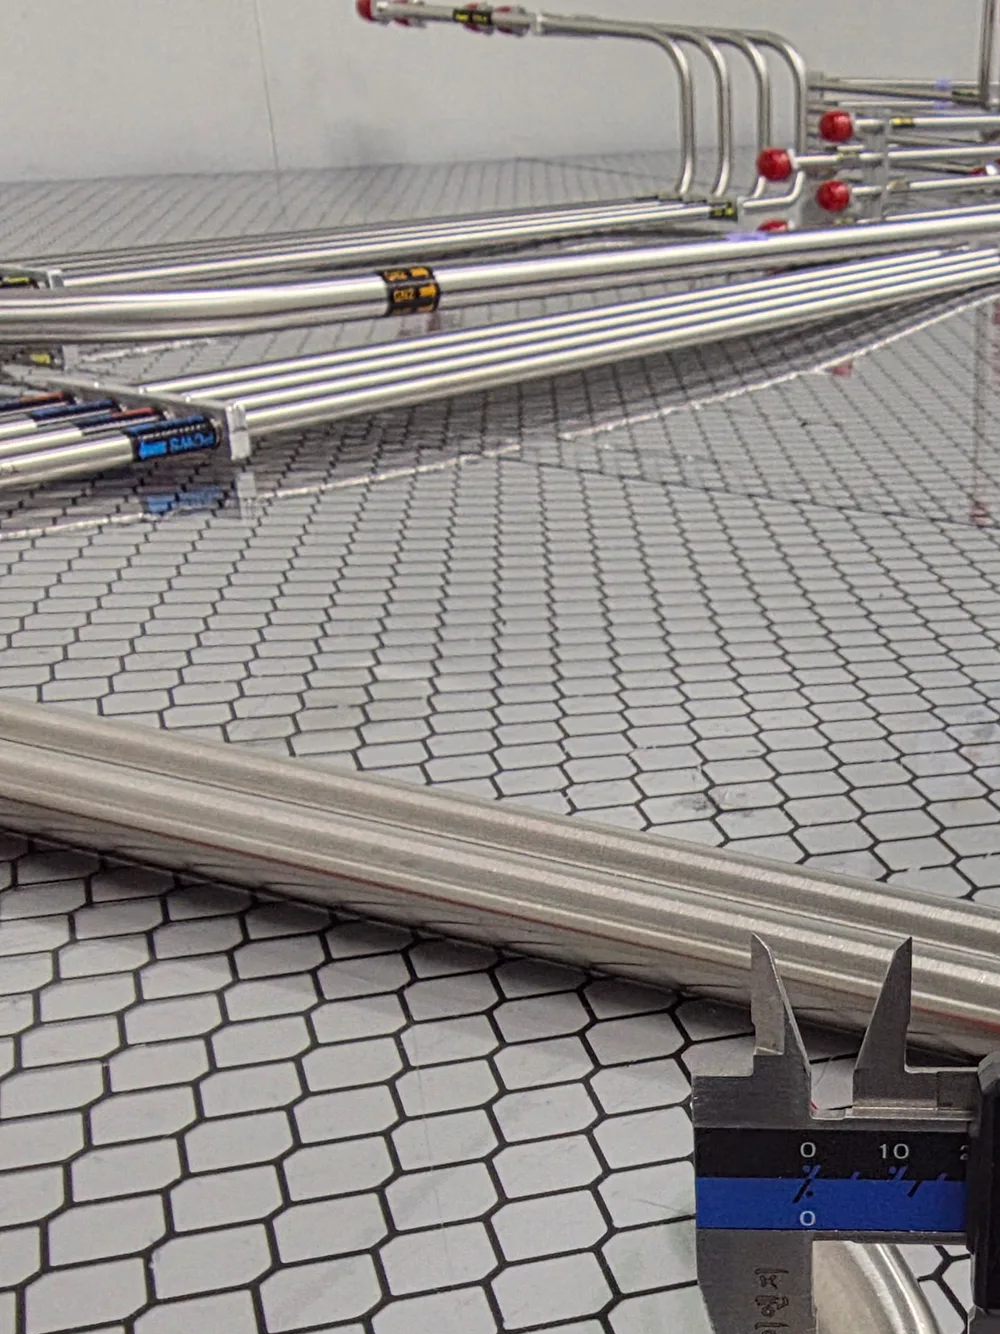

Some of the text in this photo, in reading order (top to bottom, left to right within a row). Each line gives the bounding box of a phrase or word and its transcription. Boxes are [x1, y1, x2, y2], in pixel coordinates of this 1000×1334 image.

[800, 1142, 816, 1158] 0
[879, 1143, 909, 1160] 10
[800, 1210, 816, 1227] 0
